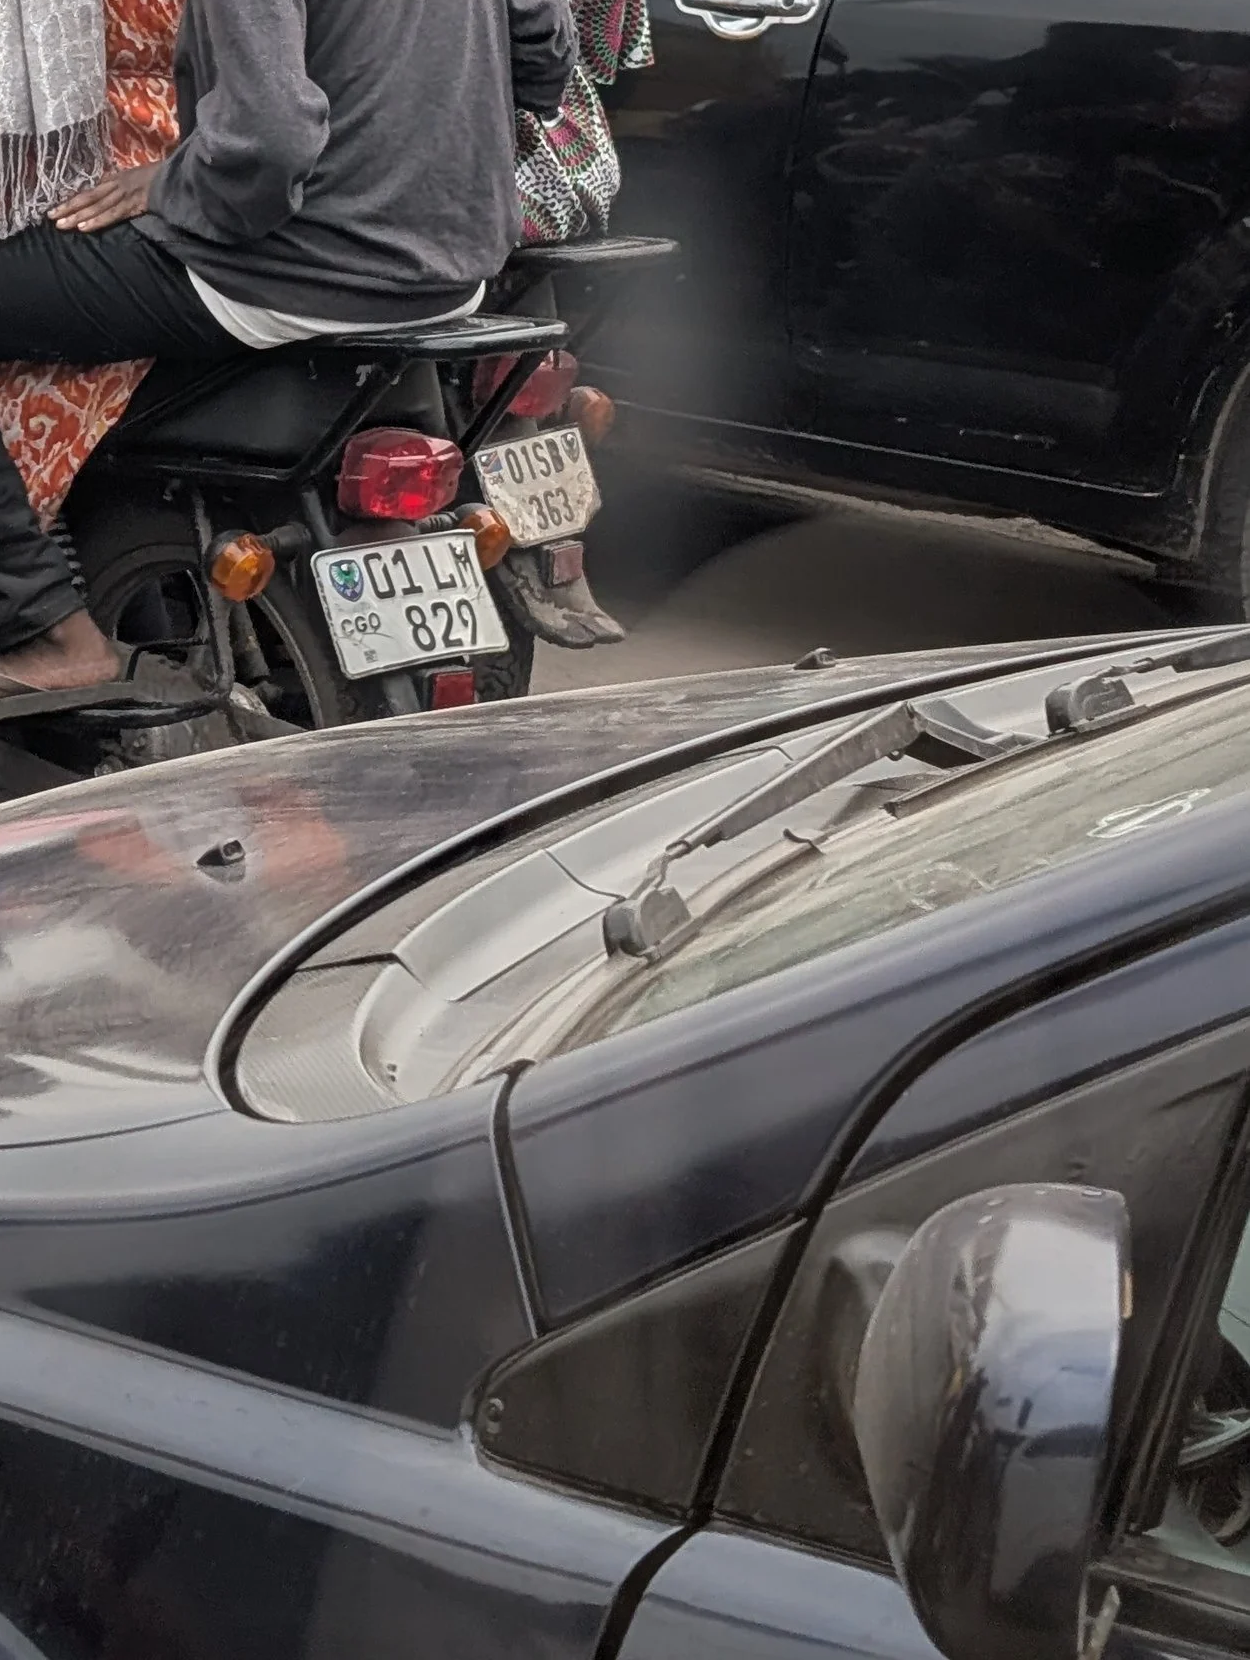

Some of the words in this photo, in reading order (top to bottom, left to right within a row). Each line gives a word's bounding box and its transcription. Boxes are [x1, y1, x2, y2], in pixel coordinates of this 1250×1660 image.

[528, 487, 575, 530] 363
[363, 547, 423, 600] 01
[404, 597, 479, 653] 829
